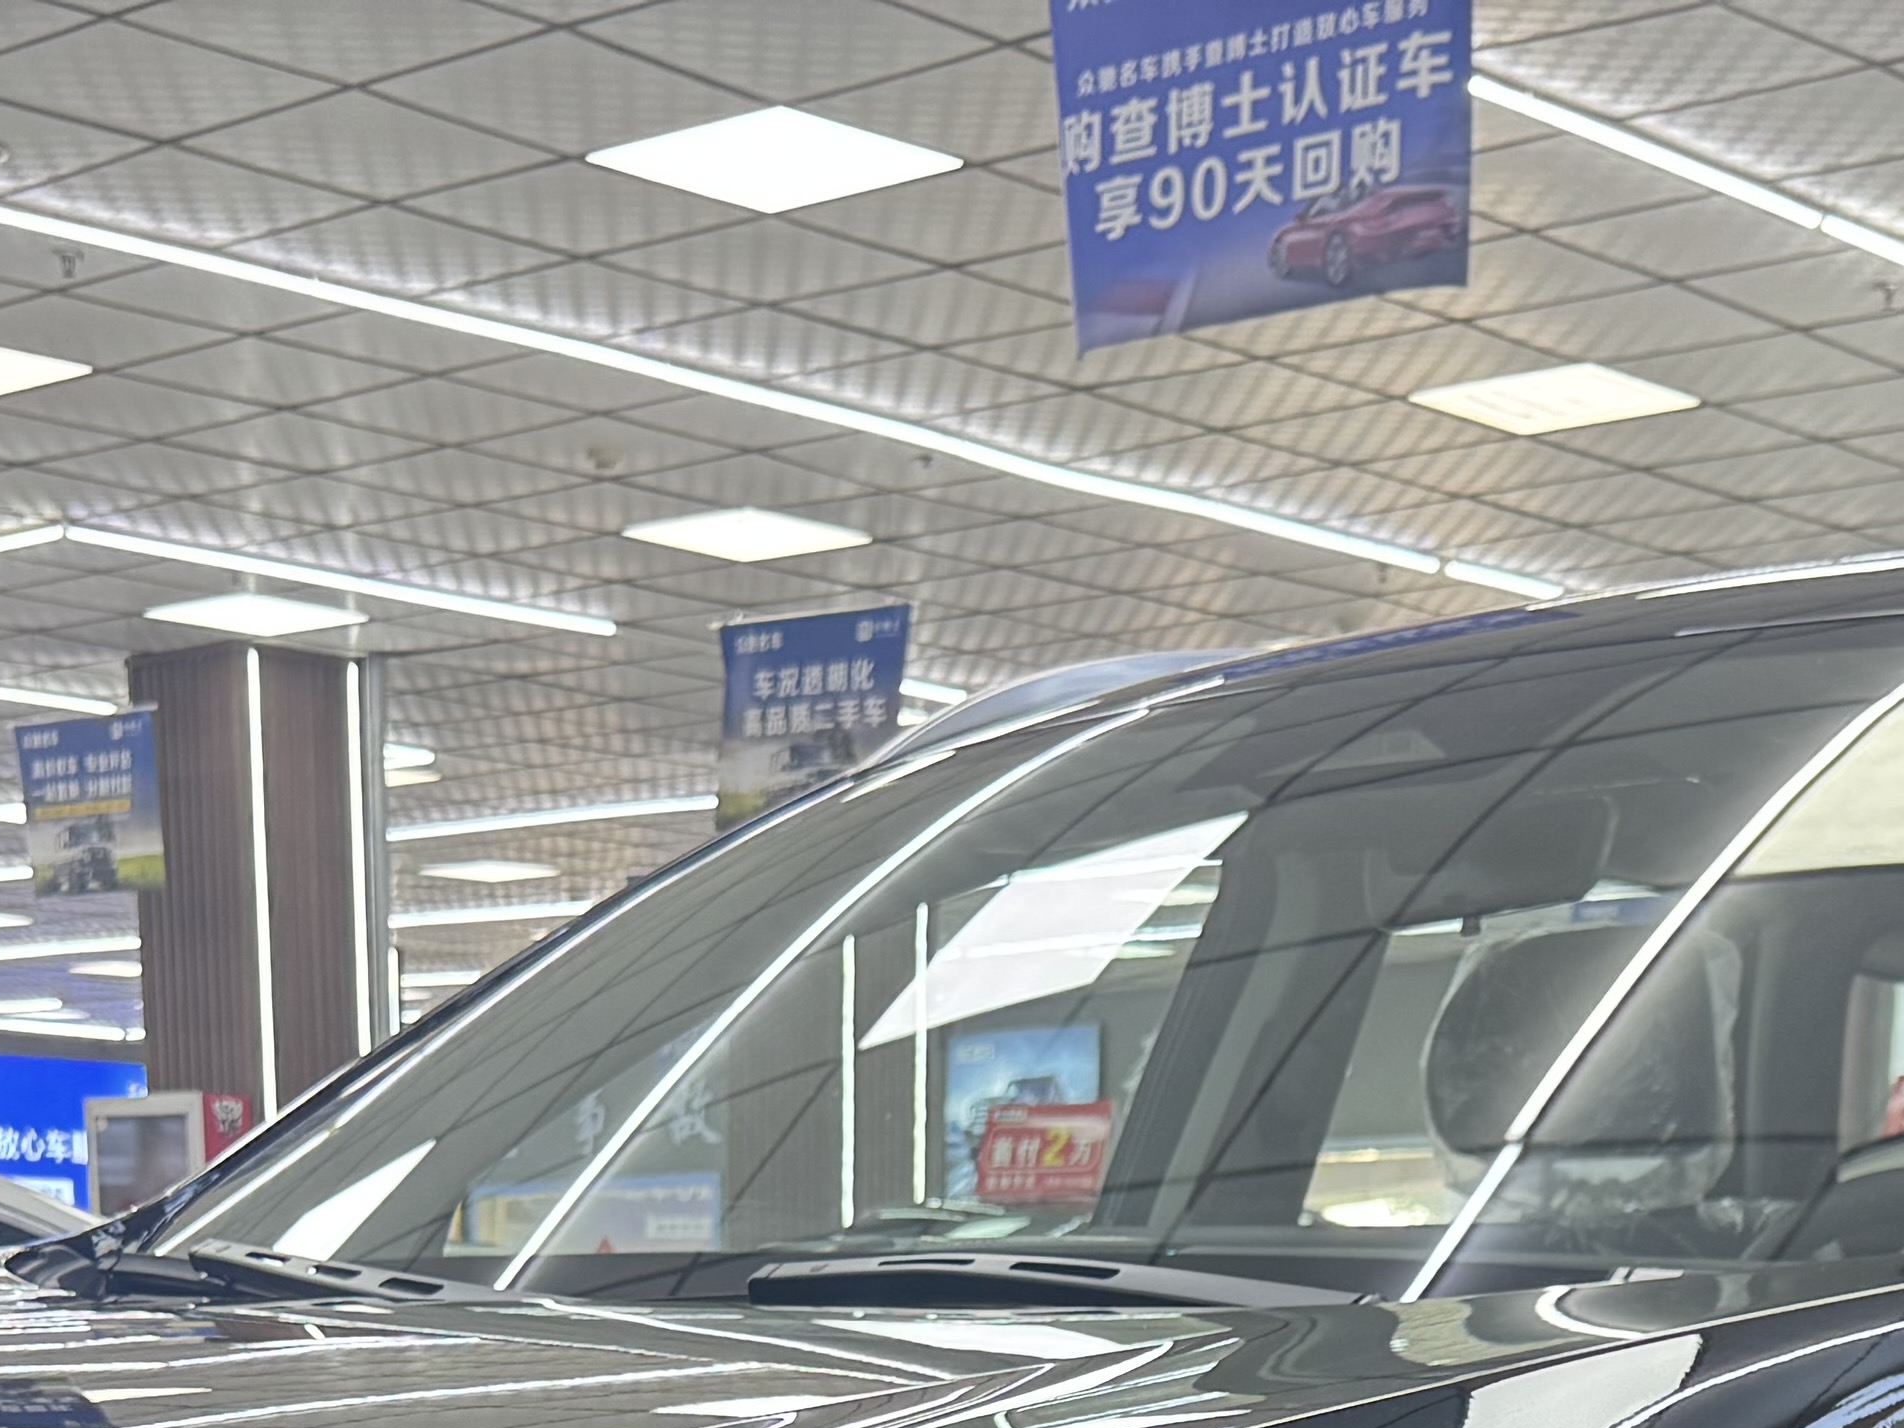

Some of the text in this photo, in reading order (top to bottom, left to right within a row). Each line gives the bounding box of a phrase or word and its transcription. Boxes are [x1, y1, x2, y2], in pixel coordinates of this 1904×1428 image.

[1062, 31, 1454, 176] 购查博士认证车
[1095, 117, 1402, 242] 享90天回购
